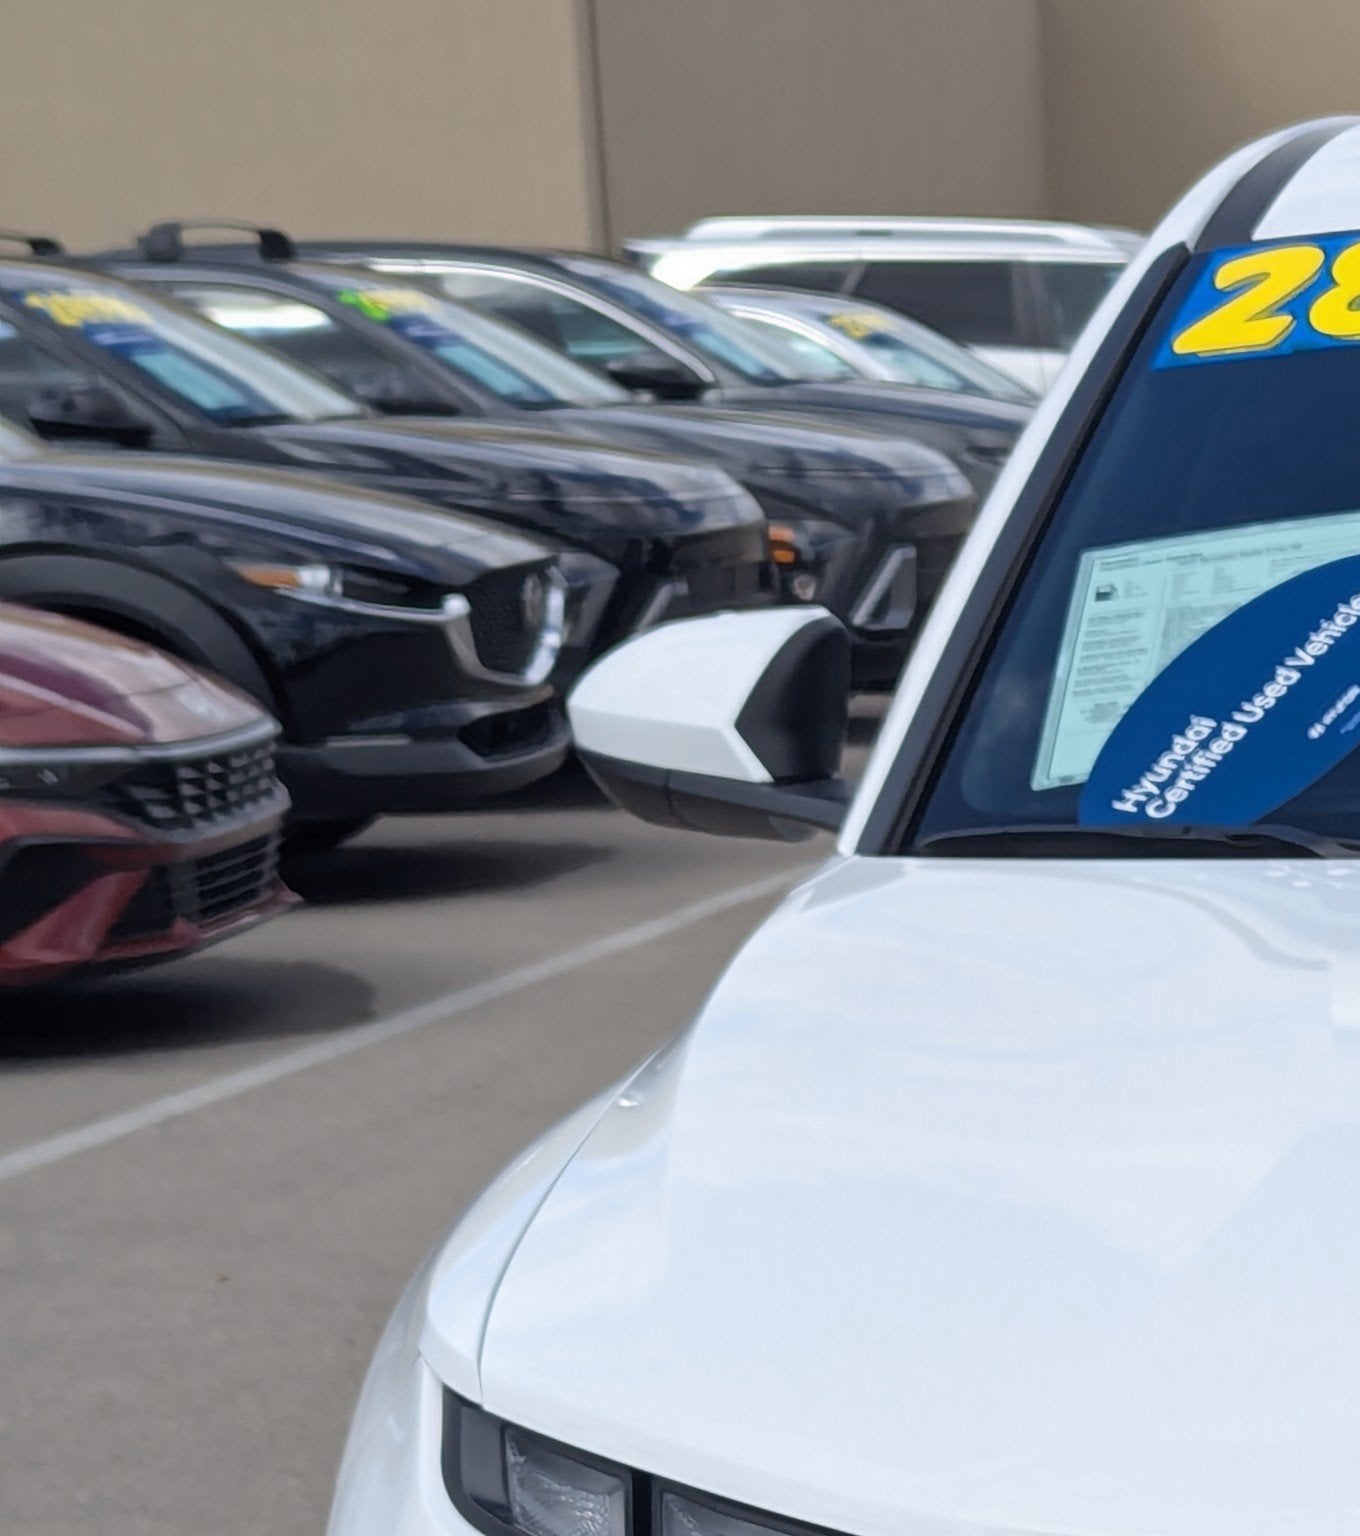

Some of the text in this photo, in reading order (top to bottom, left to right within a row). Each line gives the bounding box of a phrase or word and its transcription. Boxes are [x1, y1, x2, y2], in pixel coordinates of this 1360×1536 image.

[1111, 714, 1218, 813] Hyundai
[1145, 720, 1248, 818] Certified
[1231, 665, 1301, 723] Used
